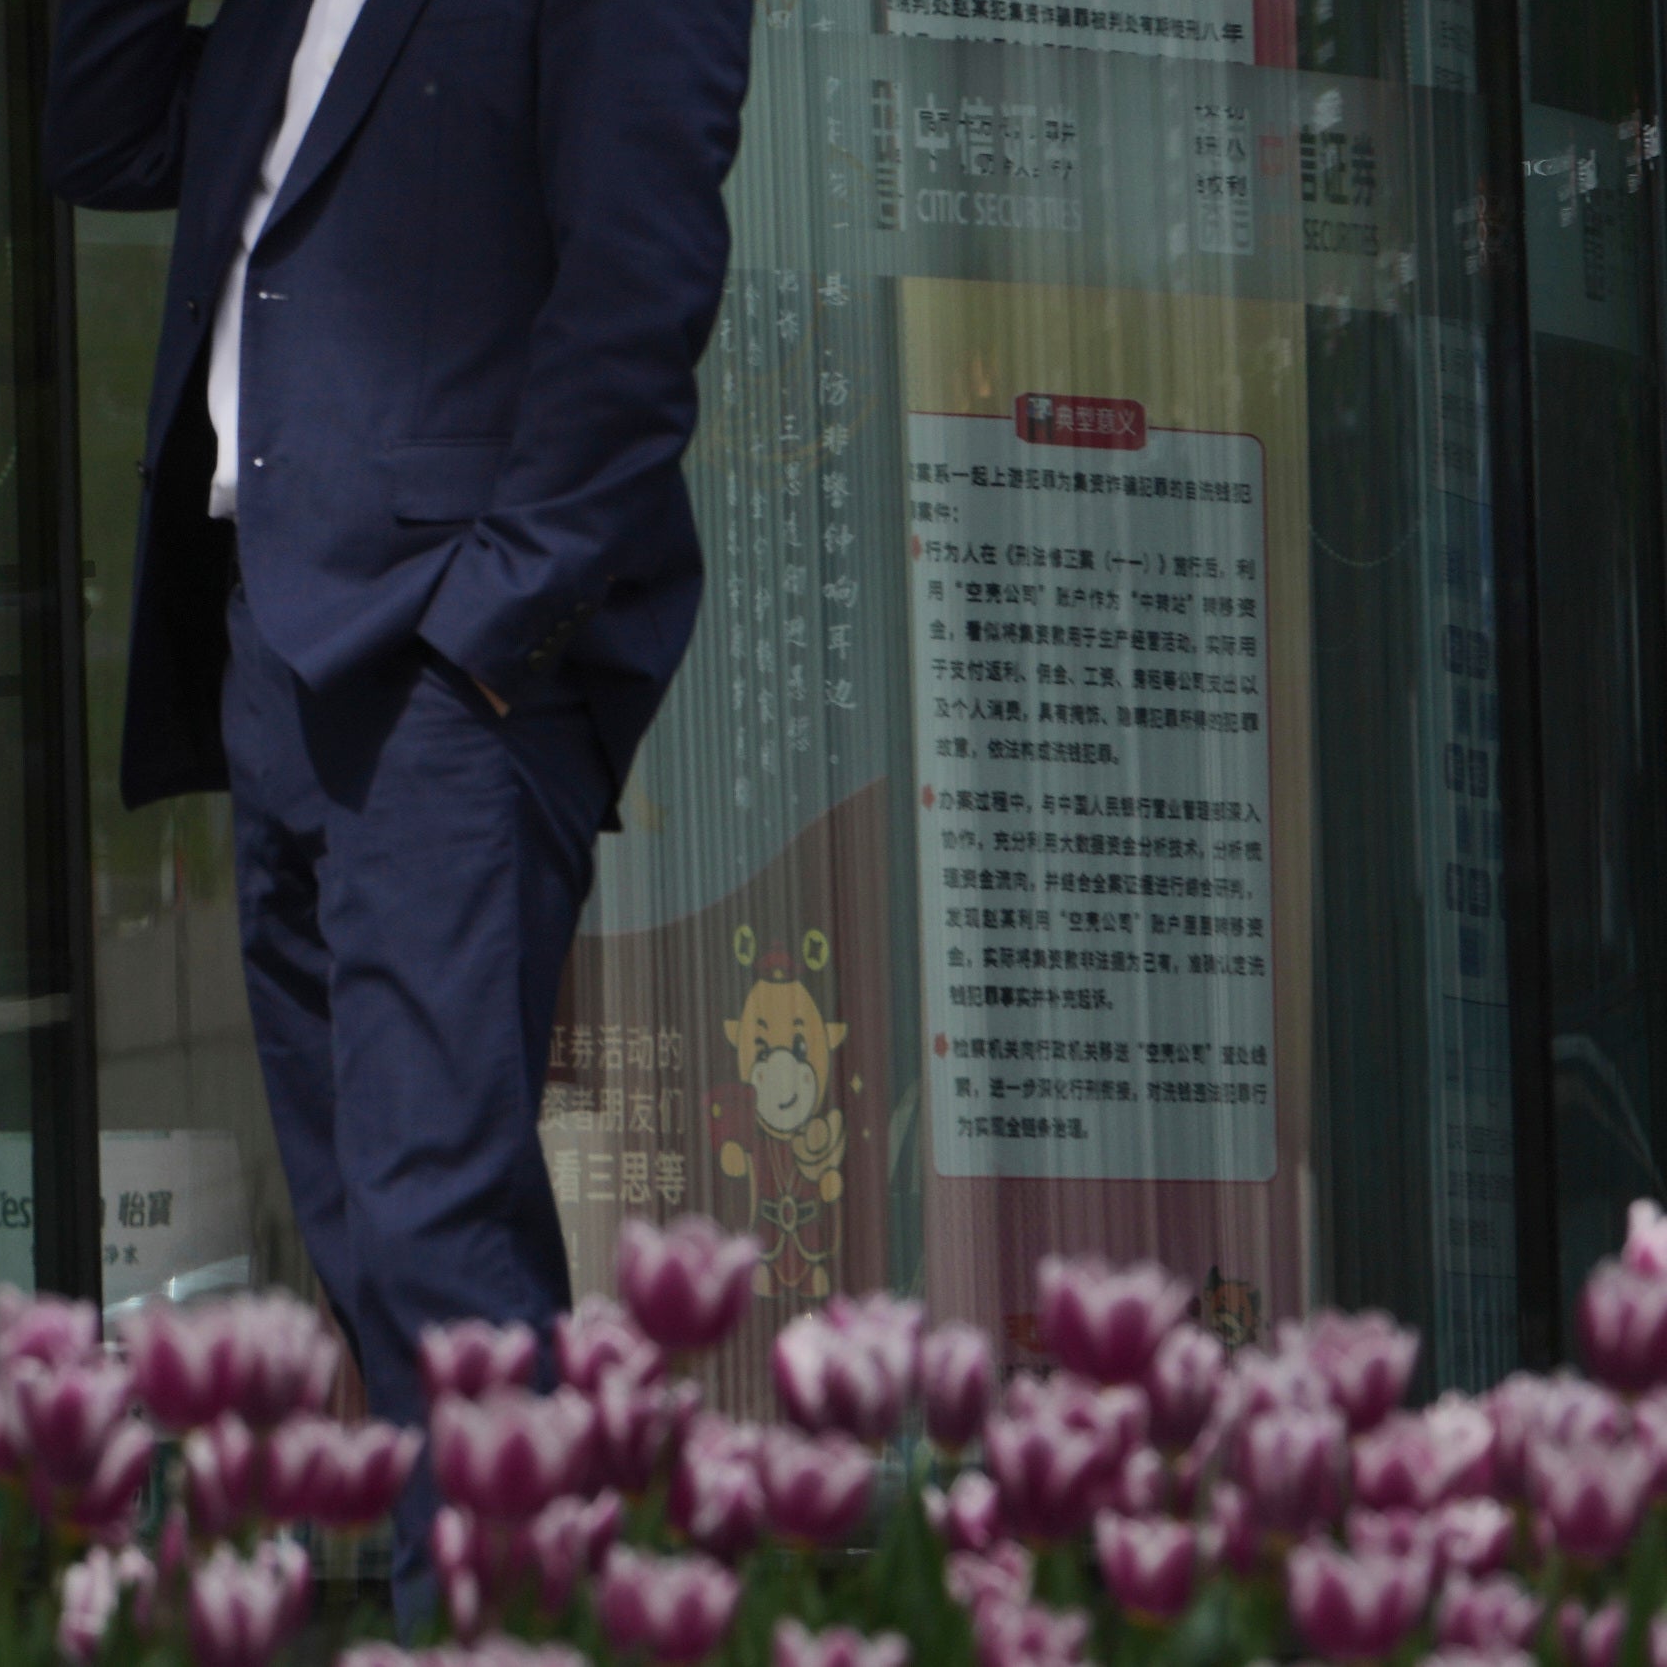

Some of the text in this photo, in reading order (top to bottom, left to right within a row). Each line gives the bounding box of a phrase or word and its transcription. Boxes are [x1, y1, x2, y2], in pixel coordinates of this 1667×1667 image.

[1054, 403, 1137, 437] 典型意义
[912, 501, 960, 525] 案件：
[541, 1088, 684, 1134] 资者朋友们
[552, 1150, 685, 1205] 看三思等
